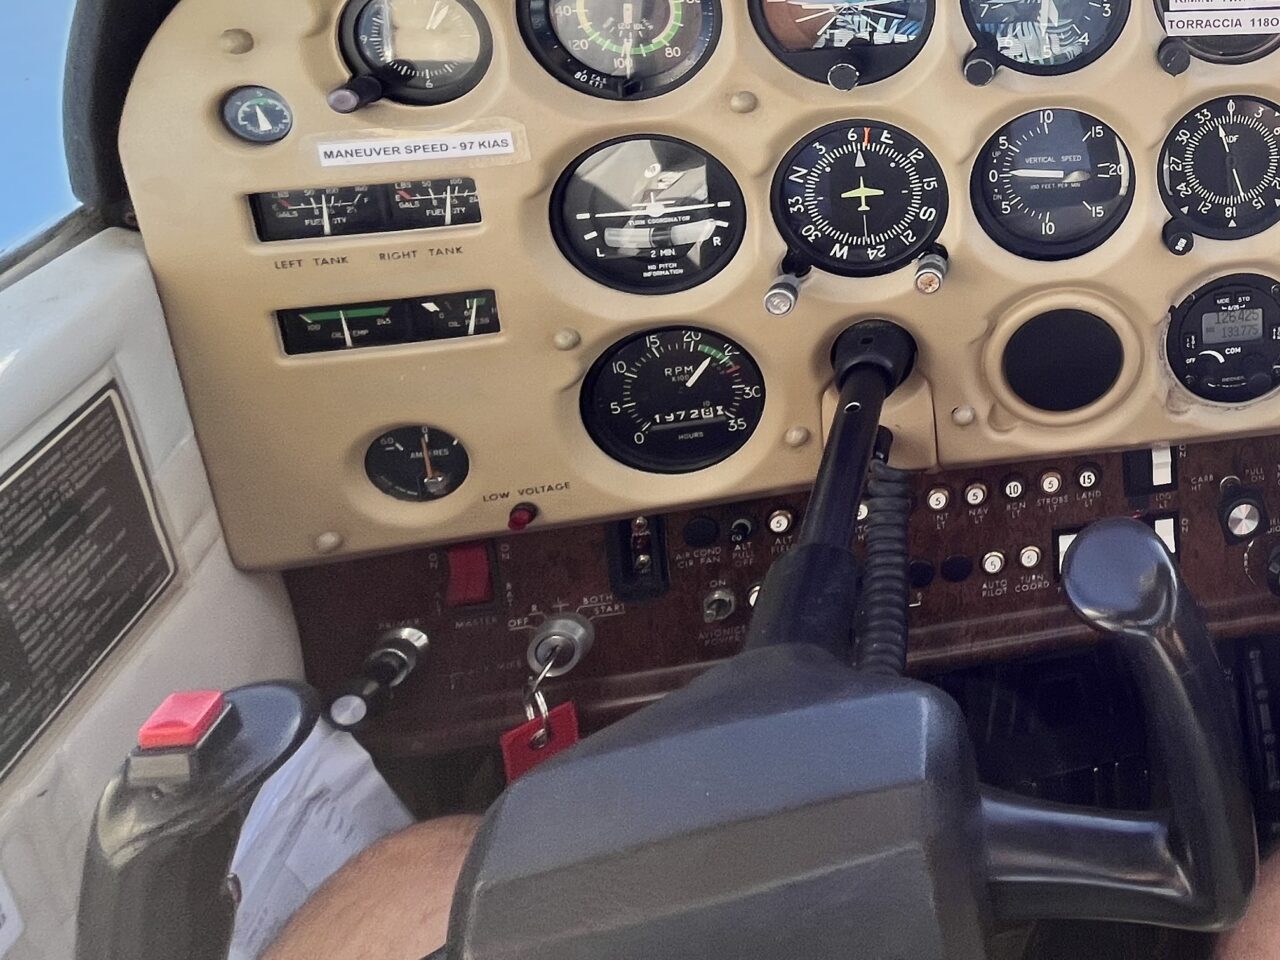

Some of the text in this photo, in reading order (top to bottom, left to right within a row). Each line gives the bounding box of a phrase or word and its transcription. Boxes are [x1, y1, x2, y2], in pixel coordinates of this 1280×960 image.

[1168, 18, 1242, 29] TORRACCIA
[664, 48, 682, 58] 80
[1039, 110, 1054, 123] 10
[1194, 108, 1212, 123] 33
[1091, 126, 1104, 138] 15
[998, 136, 1009, 149] 5
[323, 138, 510, 160] MANEUVER SPEED 97 KIAS
[907, 147, 925, 164] 12
[1025, 154, 1082, 164] VERTICAL SPEED
[1108, 163, 1125, 175] 20
[1170, 156, 1182, 171] 27
[788, 166, 809, 183] N
[989, 170, 998, 182] 0
[922, 176, 938, 189] 15
[1001, 201, 1011, 214] 5
[1091, 206, 1104, 217] 15
[647, 215, 690, 225] COORDINATOR
[919, 206, 937, 222] S
[1041, 222, 1055, 235] 10
[379, 246, 464, 262] RIGHT TANK
[866, 244, 887, 260] 24
[274, 256, 349, 270] LEFT TANK
[643, 269, 684, 278] INFORMATION
[645, 335, 660, 348] 15
[1225, 346, 1241, 355] COM
[612, 360, 627, 374] 10
[664, 365, 694, 376] RPM
[743, 386, 761, 398] 30
[610, 401, 621, 414] 5
[727, 418, 747, 431] 35
[634, 432, 645, 444] 0
[678, 431, 705, 440] HOURS
[1245, 467, 1264, 476] PULL
[1190, 474, 1214, 483] CARB
[482, 482, 571, 502] LOW VOLTAGE
[1076, 490, 1102, 501] LAND
[1036, 495, 1069, 506] STROBE
[968, 508, 989, 517] NAV
[734, 542, 753, 551] ALT
[775, 536, 794, 545] ALT
[675, 546, 722, 561] AIR COND
[677, 555, 722, 568] CIR FAN
[709, 578, 727, 587] ON
[982, 579, 1008, 589] AUTO
[1020, 574, 1044, 584] TURN
[982, 588, 1008, 597] PILOT
[1015, 580, 1050, 593] COORD
[583, 594, 613, 605] BOTH
[594, 604, 625, 615] START
[455, 617, 498, 628] MASTER
[508, 616, 529, 628] OFF
[700, 626, 747, 639] AVIONICS
